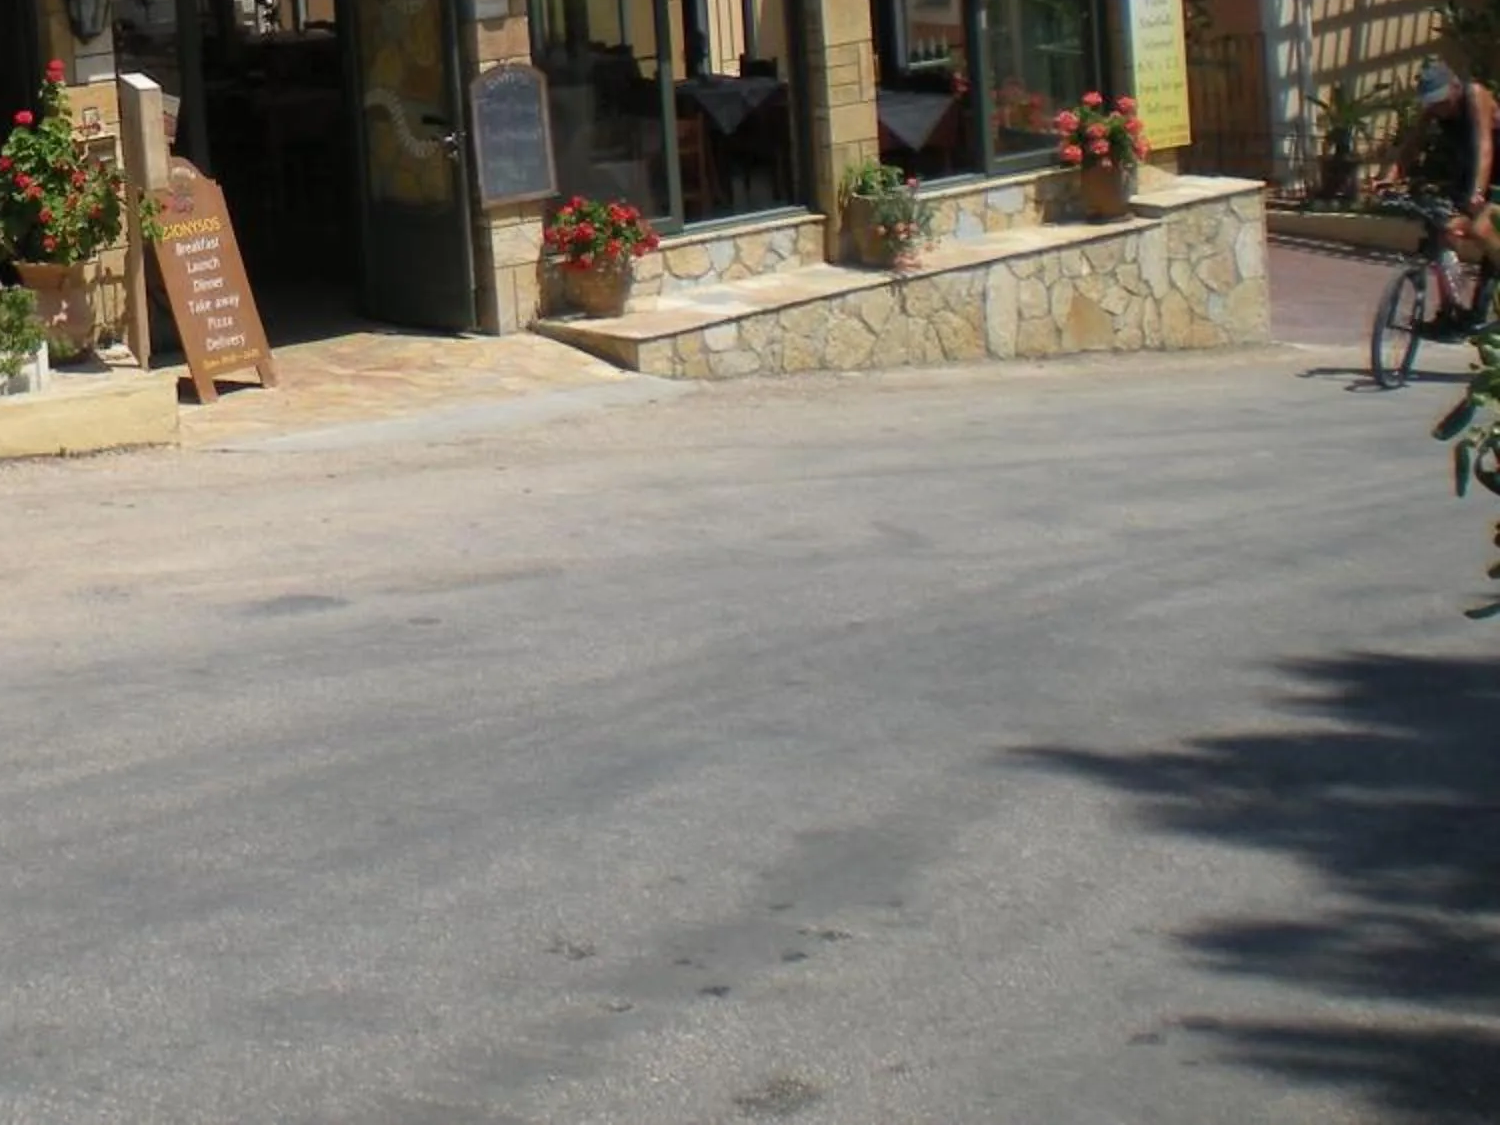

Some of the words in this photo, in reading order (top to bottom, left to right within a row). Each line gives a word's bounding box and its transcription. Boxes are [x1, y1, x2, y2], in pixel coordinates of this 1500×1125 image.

[175, 236, 220, 257] Breakfast
[193, 276, 224, 294] Dinner
[206, 333, 246, 353] Delivery
